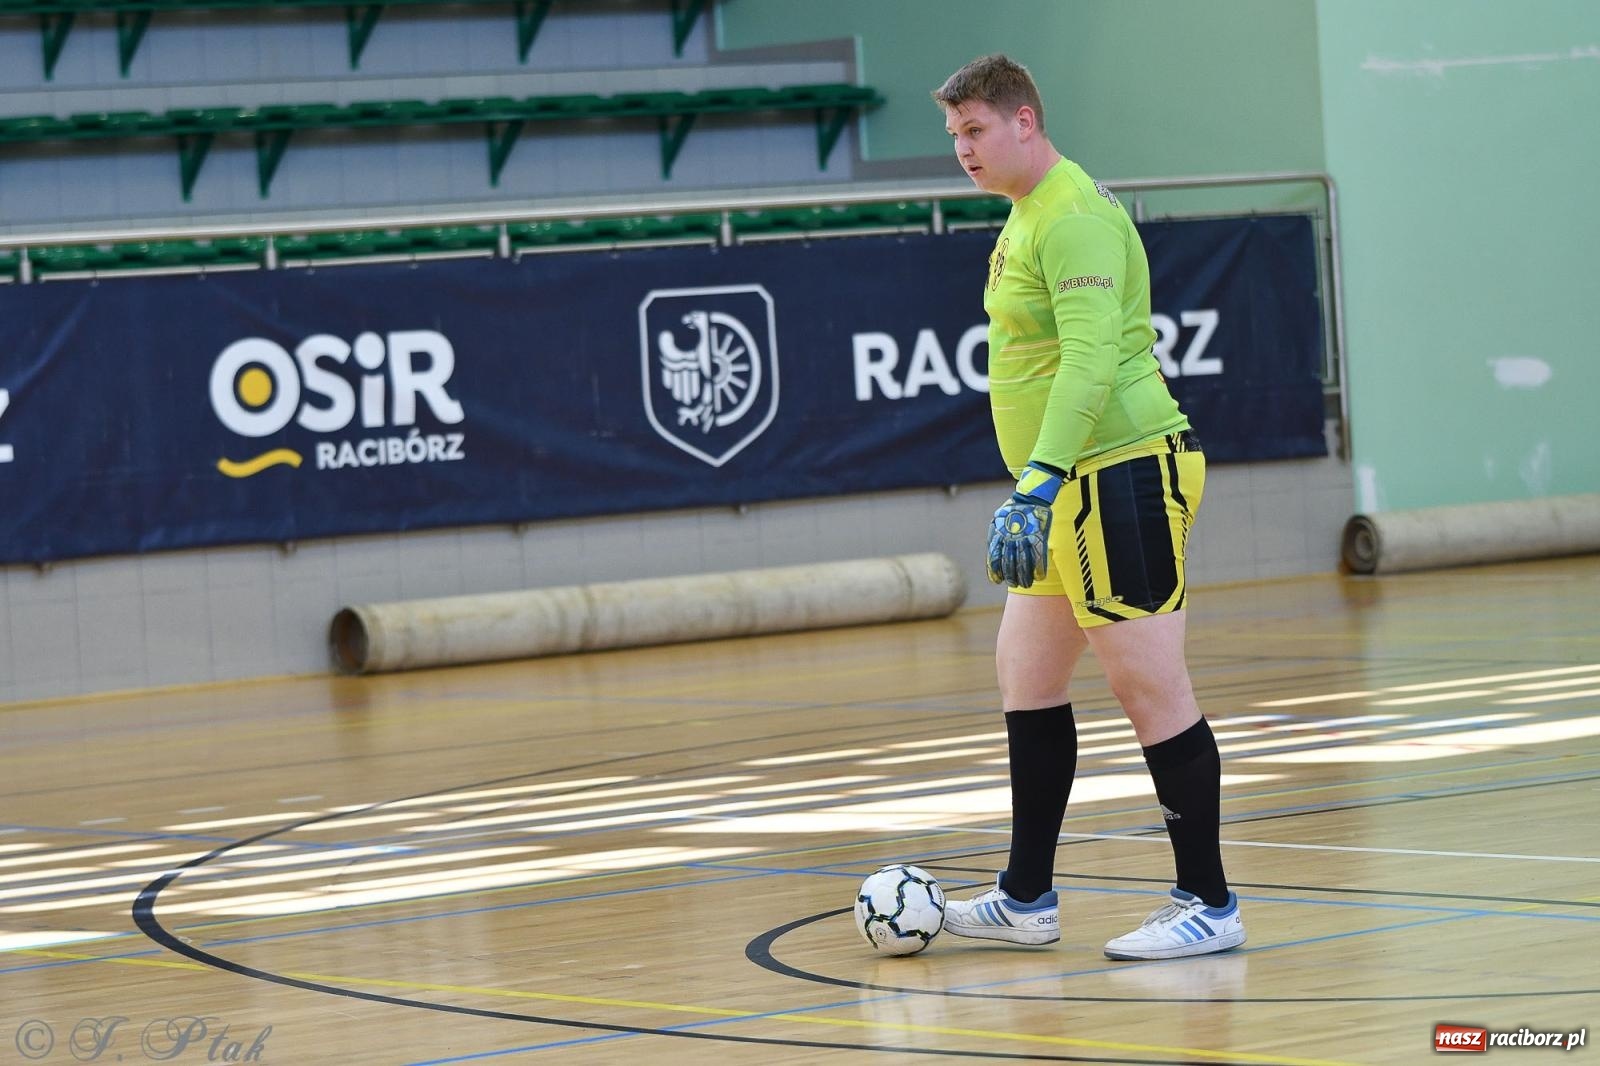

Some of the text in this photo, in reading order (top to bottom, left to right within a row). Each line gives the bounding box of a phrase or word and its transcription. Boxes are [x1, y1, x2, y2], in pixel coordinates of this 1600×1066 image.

[1058, 276, 1113, 293] BVB1909.pl
[852, 308, 1223, 401] RACRZ
[316, 428, 465, 470] RACIBÓRZ
